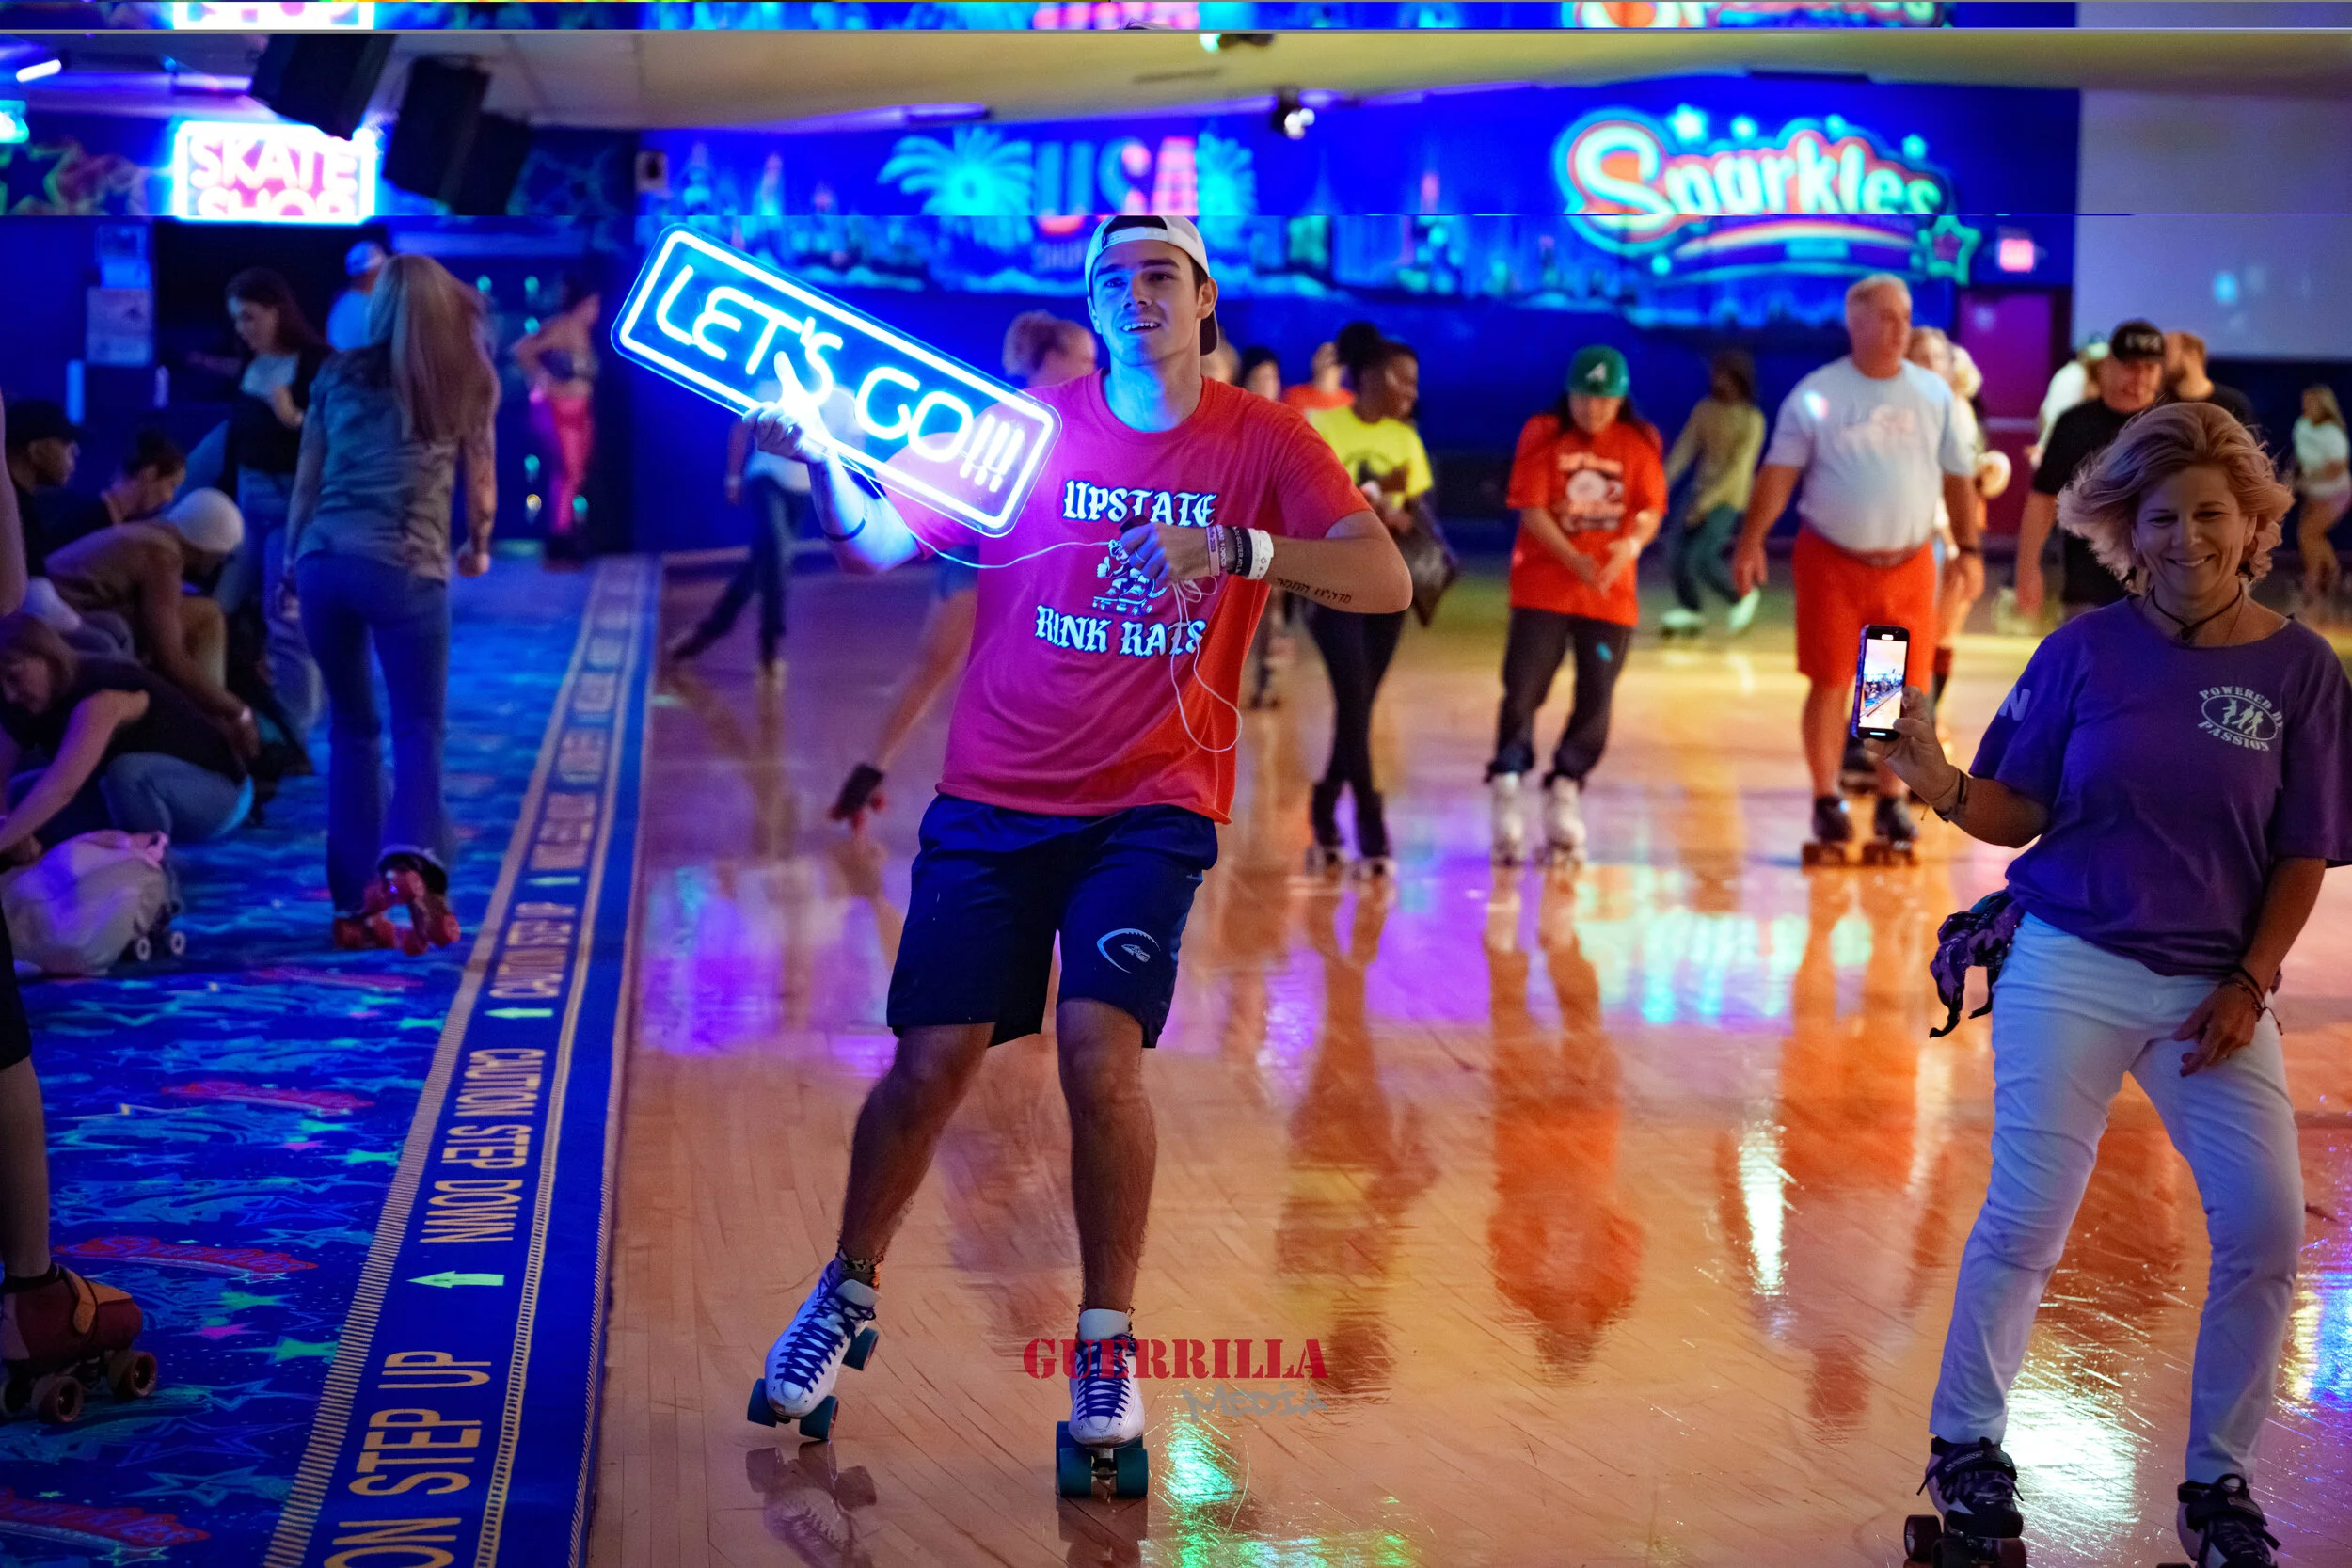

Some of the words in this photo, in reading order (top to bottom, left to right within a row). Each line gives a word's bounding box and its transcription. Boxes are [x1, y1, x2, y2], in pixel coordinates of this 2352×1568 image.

[188, 135, 359, 190] SKATE
[854, 366, 1025, 493] GO!!!
[1063, 480, 1218, 527] UPSTATE
[1035, 605, 1113, 653] RINK
[1119, 620, 1207, 657] RATS
[2199, 686, 2272, 709] POWERED
[2198, 721, 2269, 752] PASSION
[454, 1048, 546, 1117] CAUTION
[440, 1124, 532, 1169] STEP
[420, 1179, 523, 1243] DOWN
[377, 1351, 492, 1389] UP
[348, 1408, 483, 1496] STEP
